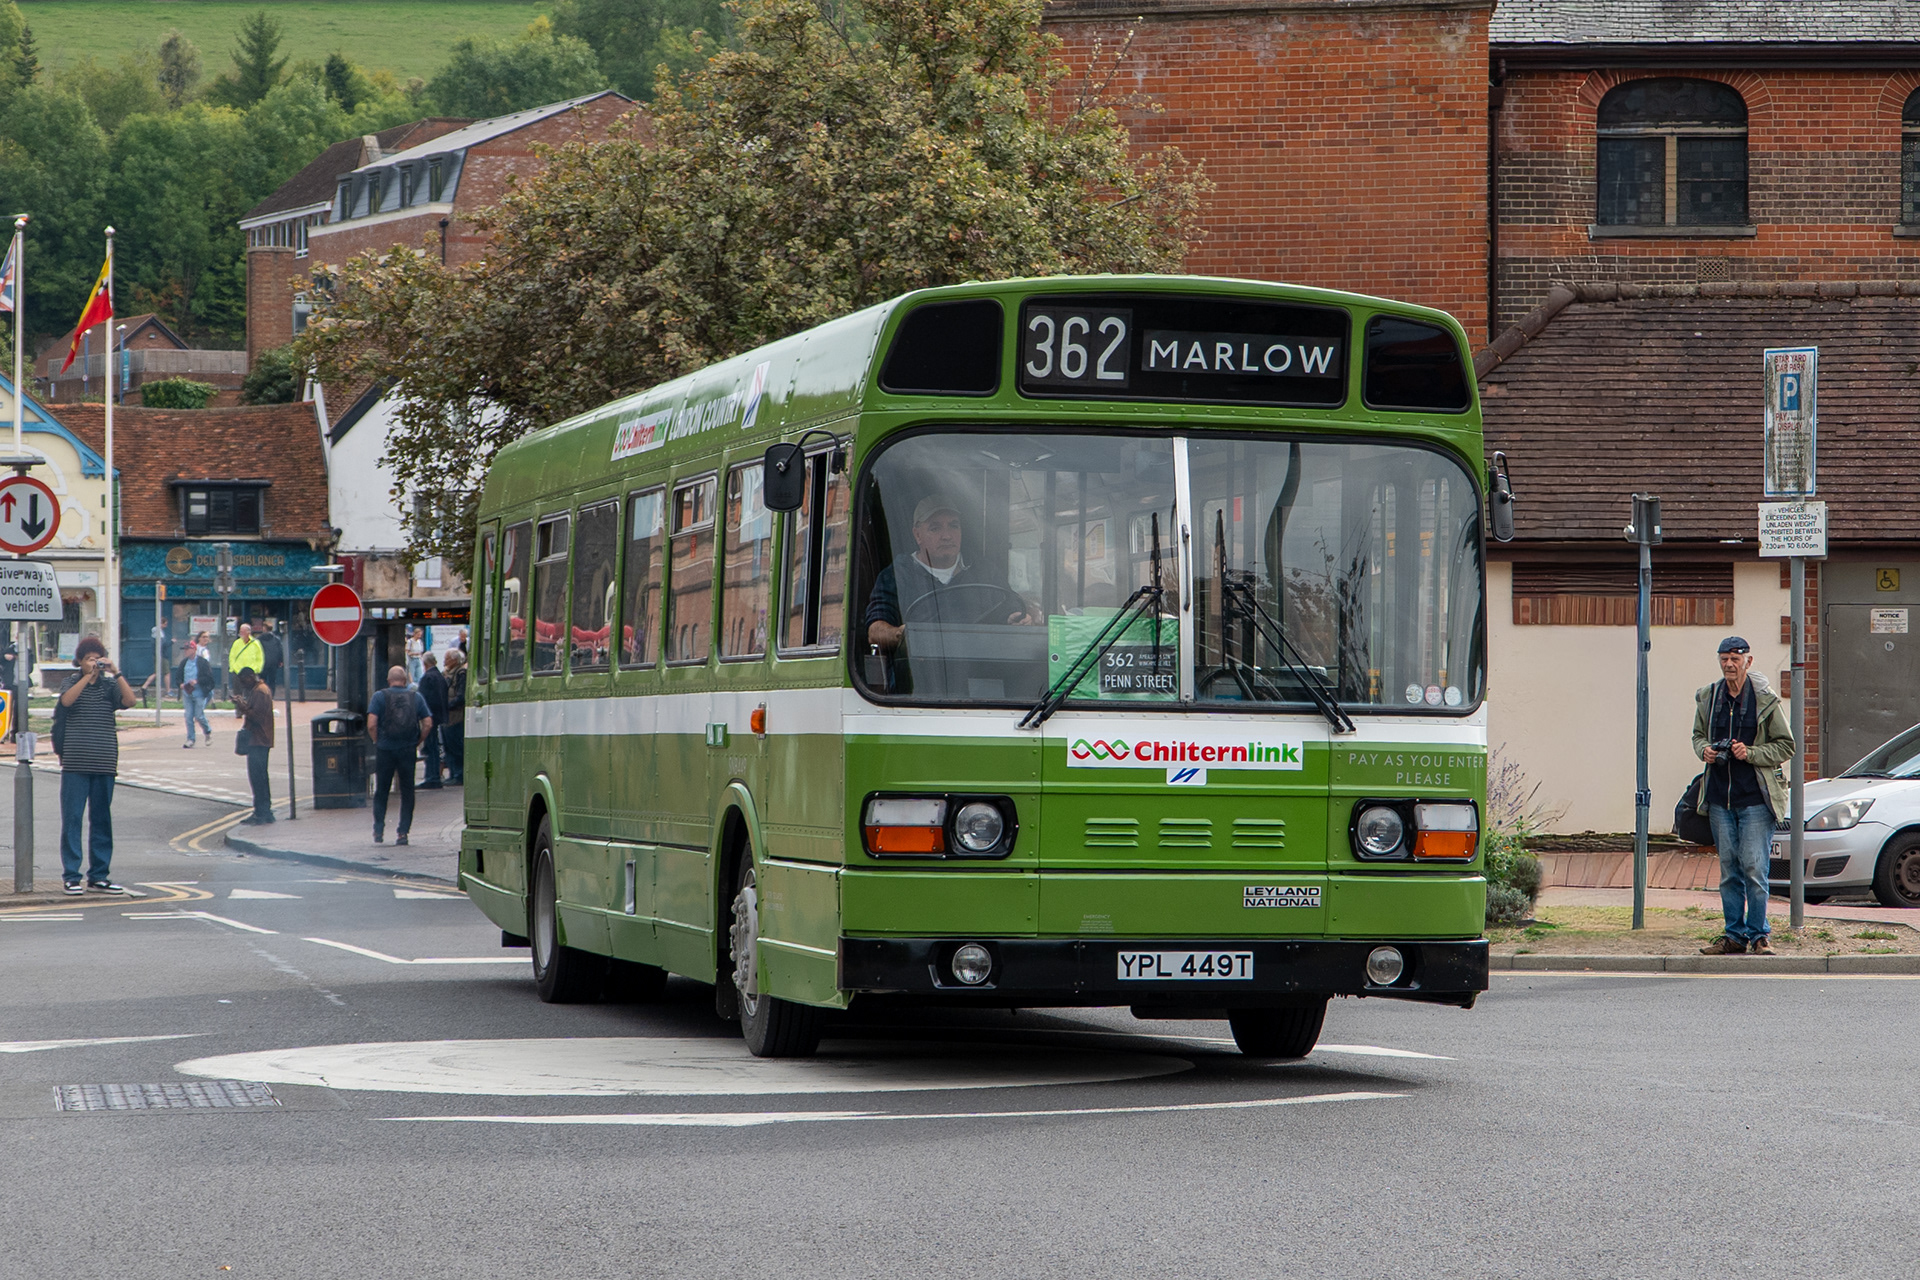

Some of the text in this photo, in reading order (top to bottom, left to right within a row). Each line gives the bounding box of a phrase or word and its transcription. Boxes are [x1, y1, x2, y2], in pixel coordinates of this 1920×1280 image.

[1026, 314, 1334, 381] 362 MARLOW
[1775, 354, 1807, 363] STAR YARD
[1775, 363, 1805, 372] CAR PARK
[1783, 376, 1798, 408] P
[667, 402, 706, 442] LONDON
[701, 390, 745, 433] COUNTRY
[1776, 411, 1788, 421] PAY
[1777, 421, 1803, 432] DISPLAY
[1777, 506, 1805, 514] VEHICLES
[1794, 520, 1817, 528] WEIGHT
[232, 554, 285, 566] SABLANCA
[24, 570, 43, 583] way
[45, 569, 54, 581] to
[1, 584, 53, 599] oncoming
[5, 600, 50, 613] vehicles
[1106, 653, 1134, 667] 362
[1104, 674, 1174, 688] PENN STREET
[1134, 740, 1300, 763] Chilternlink
[1348, 753, 1484, 768] PAY AS YOU ENTER
[1396, 772, 1450, 785] PLEASE
[1245, 887, 1320, 896] LEYLAND
[1245, 898, 1319, 907] NATIONAL
[1120, 954, 1251, 977] YPL 449T
